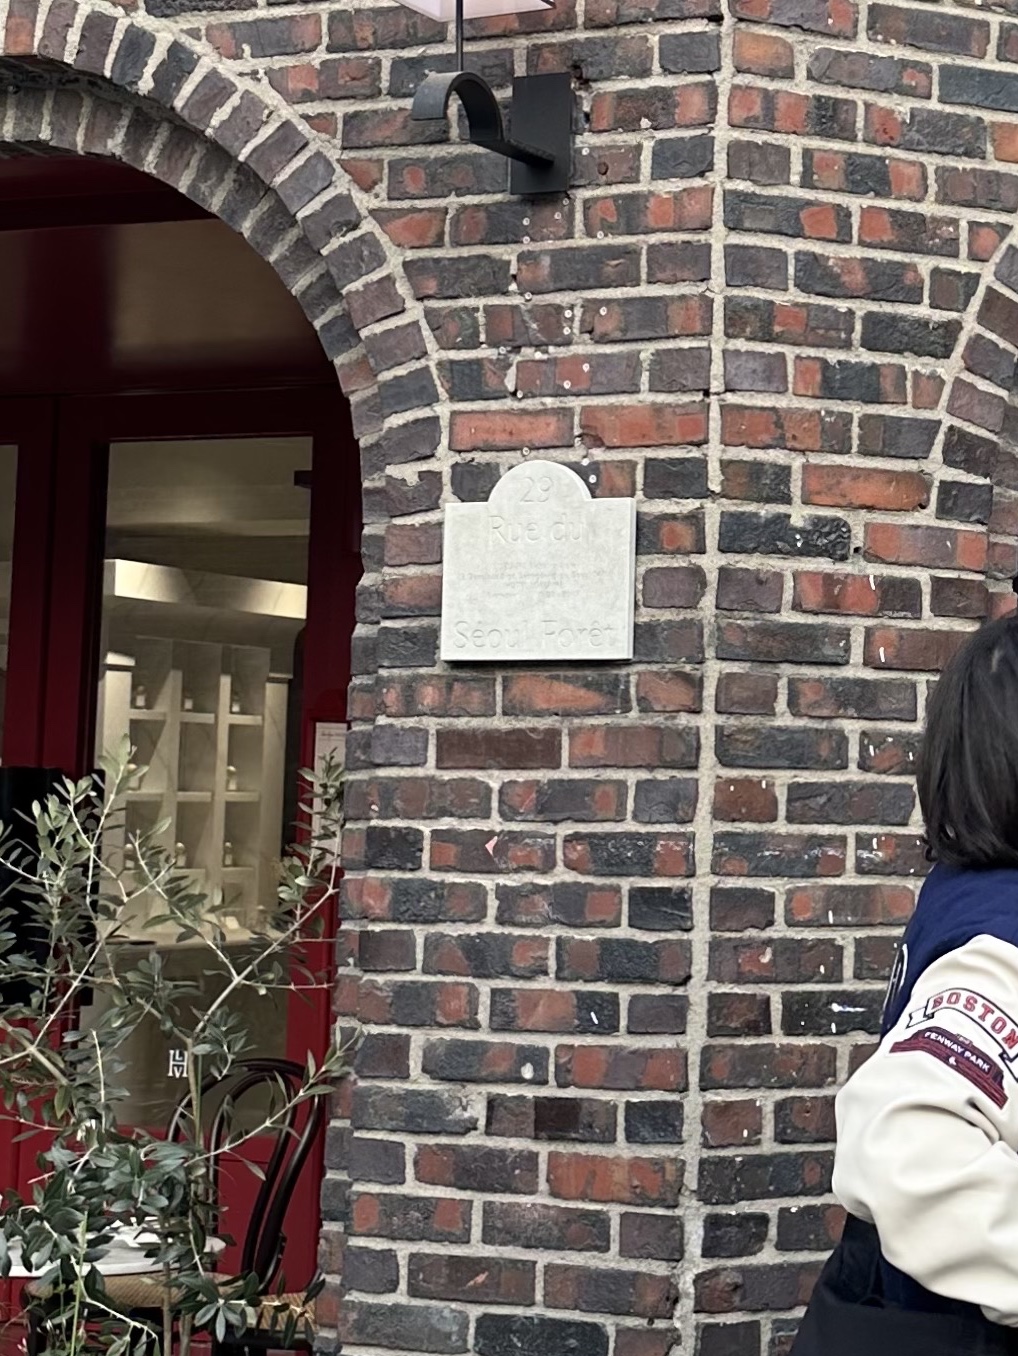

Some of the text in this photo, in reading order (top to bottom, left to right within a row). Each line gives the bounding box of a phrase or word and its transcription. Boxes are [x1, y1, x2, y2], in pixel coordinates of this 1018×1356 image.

[519, 476, 554, 504] 29
[489, 512, 583, 544] Rue du
[541, 619, 615, 648] Forêt
[924, 1030, 991, 1073] FENWAY PARK
